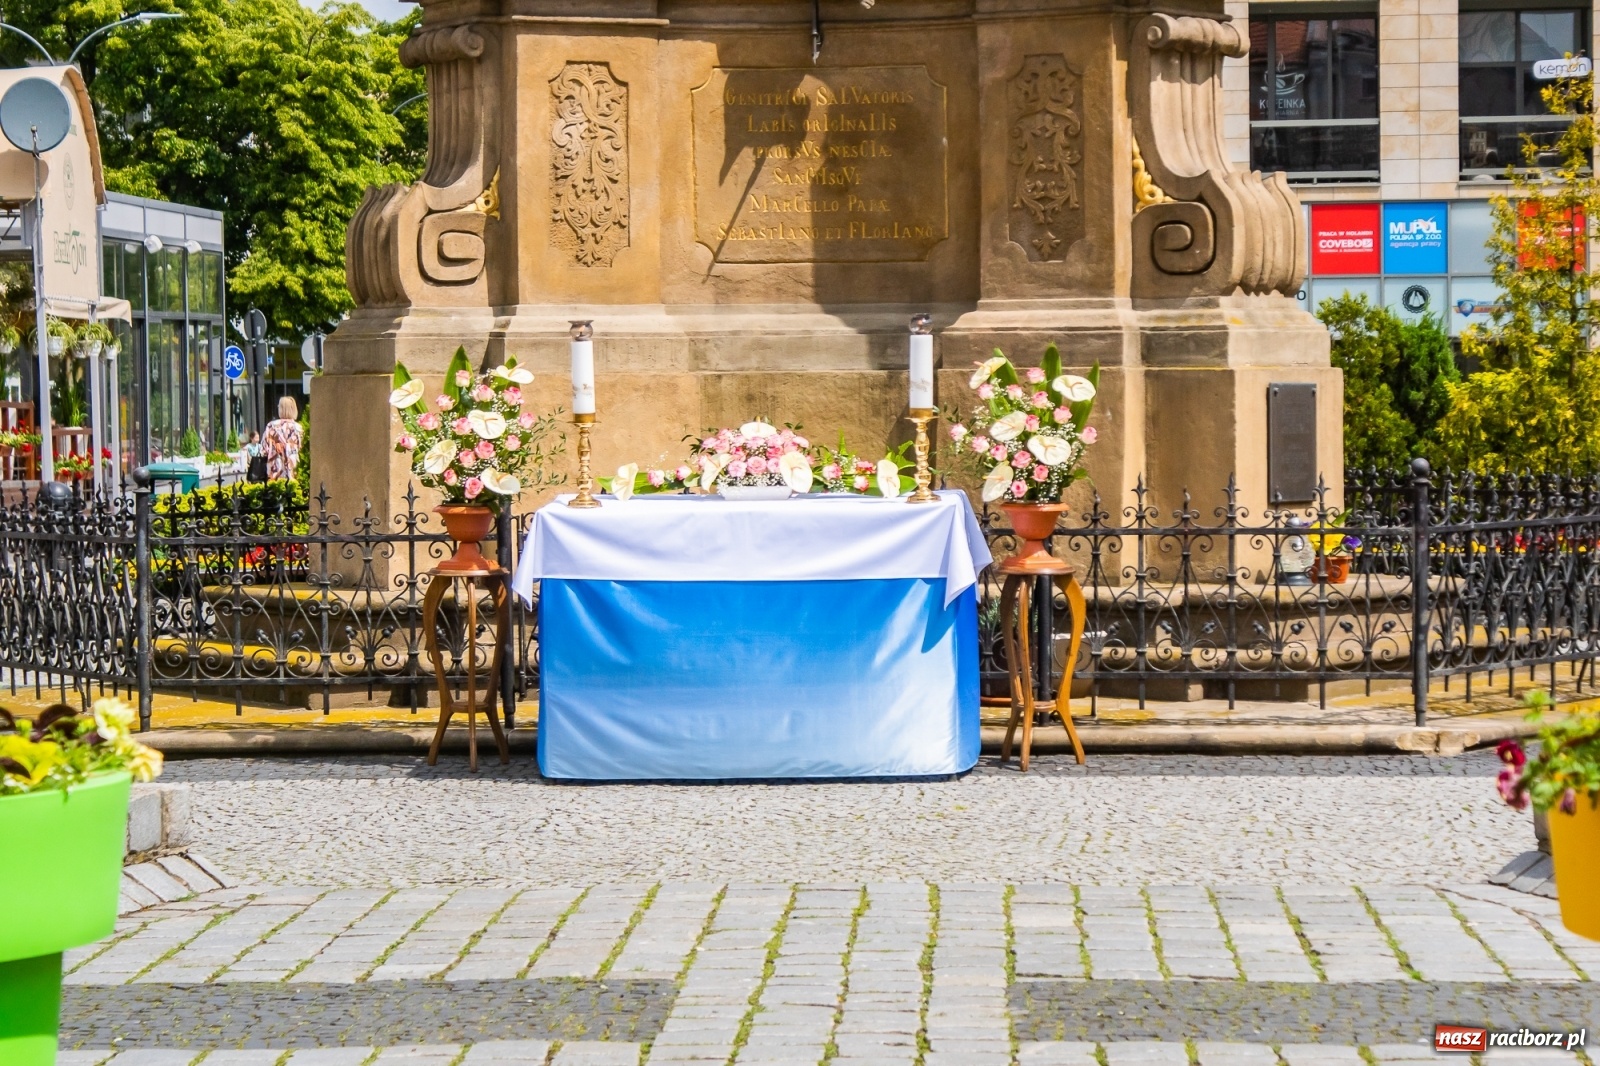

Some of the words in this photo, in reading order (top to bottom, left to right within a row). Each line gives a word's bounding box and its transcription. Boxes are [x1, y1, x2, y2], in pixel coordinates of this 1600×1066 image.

[816, 86, 915, 106] SALVATORIS
[1259, 98, 1306, 109] KEINKA
[747, 113, 796, 132] LABIS
[749, 194, 839, 213] MARCELLO
[716, 222, 819, 240] SEBASTIANO
[825, 227, 843, 239] ET
[849, 221, 933, 239] FLORIANO
[1389, 218, 1442, 234] MUPOL
[1421, 240, 1441, 248] pracy
